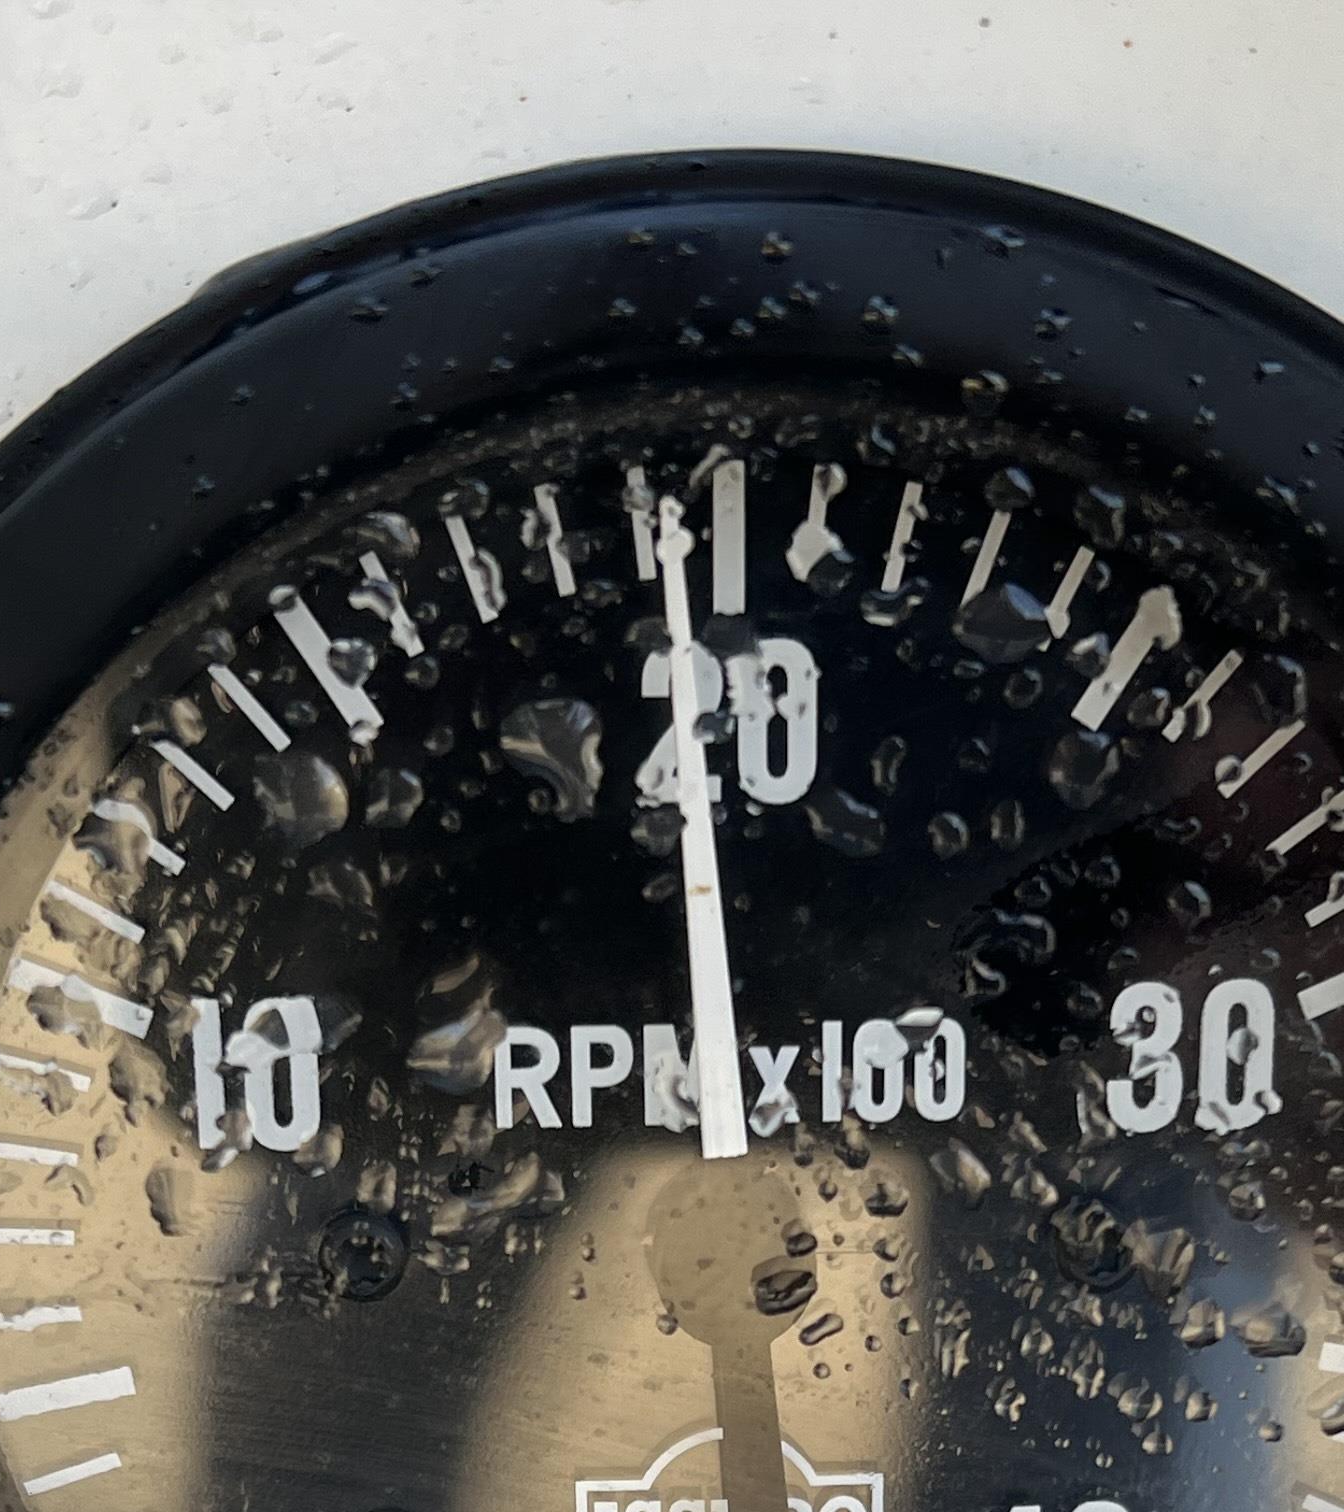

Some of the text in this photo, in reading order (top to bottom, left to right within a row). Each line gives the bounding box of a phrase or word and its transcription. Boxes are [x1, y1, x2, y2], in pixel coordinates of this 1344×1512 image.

[635, 637, 820, 806] 20
[190, 995, 323, 1152] 10
[1106, 976, 1278, 1134] 30
